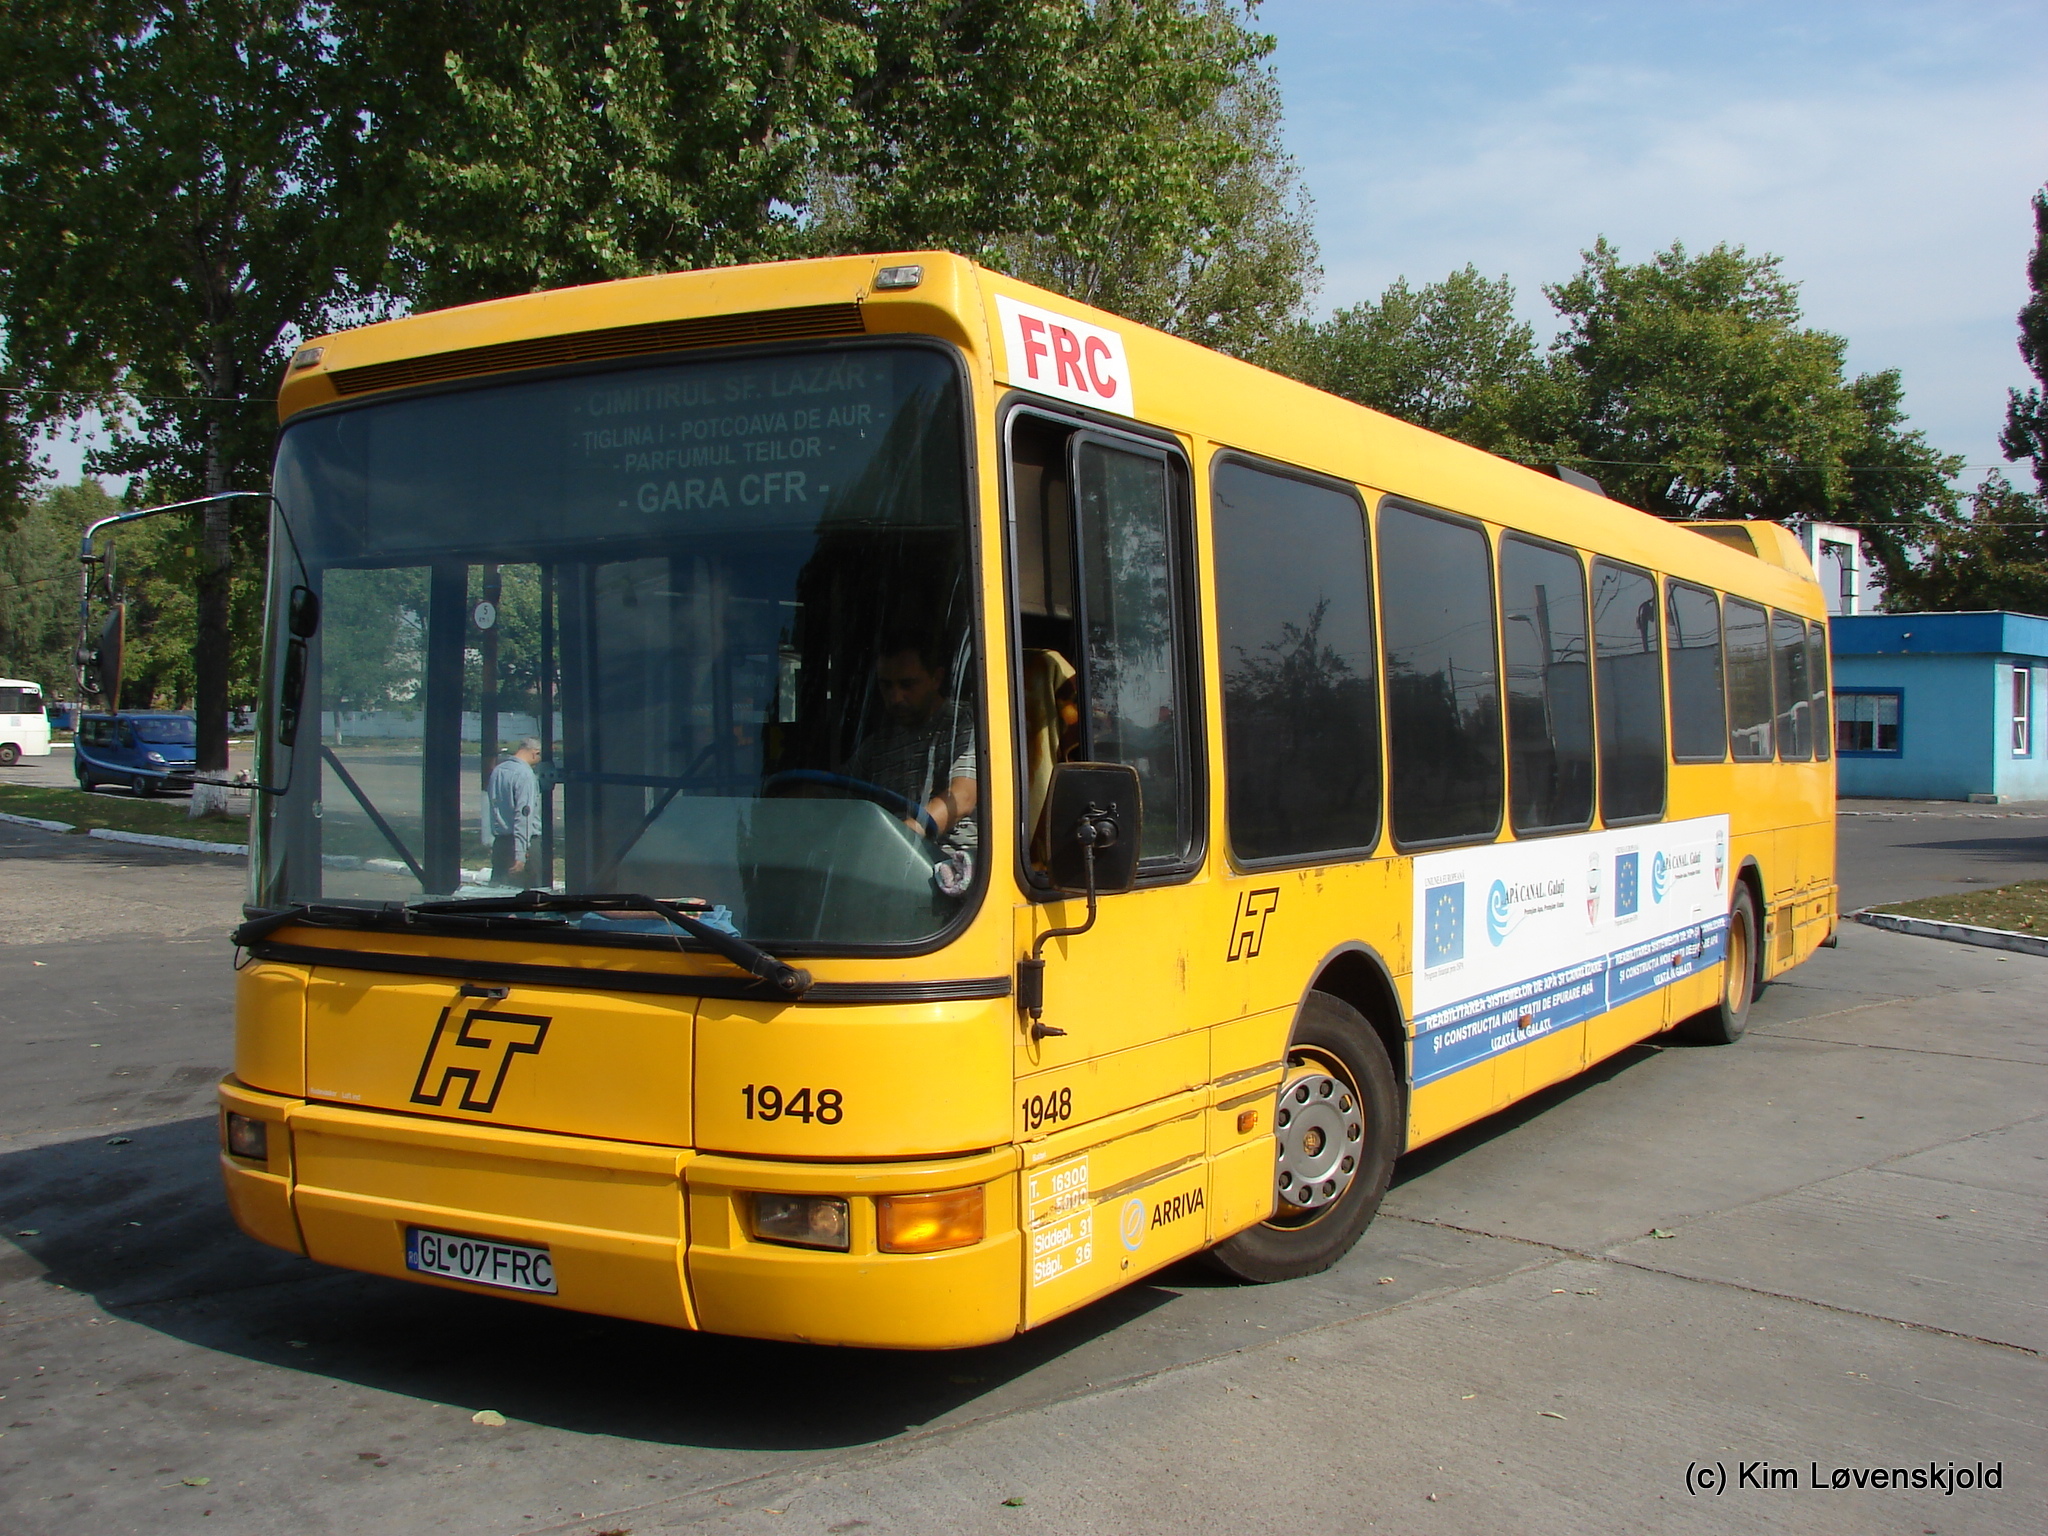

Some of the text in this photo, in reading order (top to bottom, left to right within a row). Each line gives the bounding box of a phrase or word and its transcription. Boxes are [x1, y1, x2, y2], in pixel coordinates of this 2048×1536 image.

[1018, 314, 1117, 398] FRC
[587, 380, 716, 416] CIMITIRUL
[723, 376, 762, 403] SF.
[582, 424, 655, 450] TIGLINA
[681, 412, 788, 441] POTCOAVA
[793, 408, 821, 430] DE
[826, 404, 872, 428] AUR
[625, 445, 736, 473] PARFUMUL
[743, 436, 822, 463] TEILOR
[637, 477, 730, 513] GARA
[739, 471, 808, 506] CFR
[742, 1084, 843, 1125] 1948
[1022, 1087, 1072, 1133] 1948
[1052, 1165, 1087, 1193] 16300
[1150, 1187, 1204, 1230] ARRIVA
[1035, 1216, 1091, 1254] Siddepl. 31
[1075, 1243, 1091, 1264] 36
